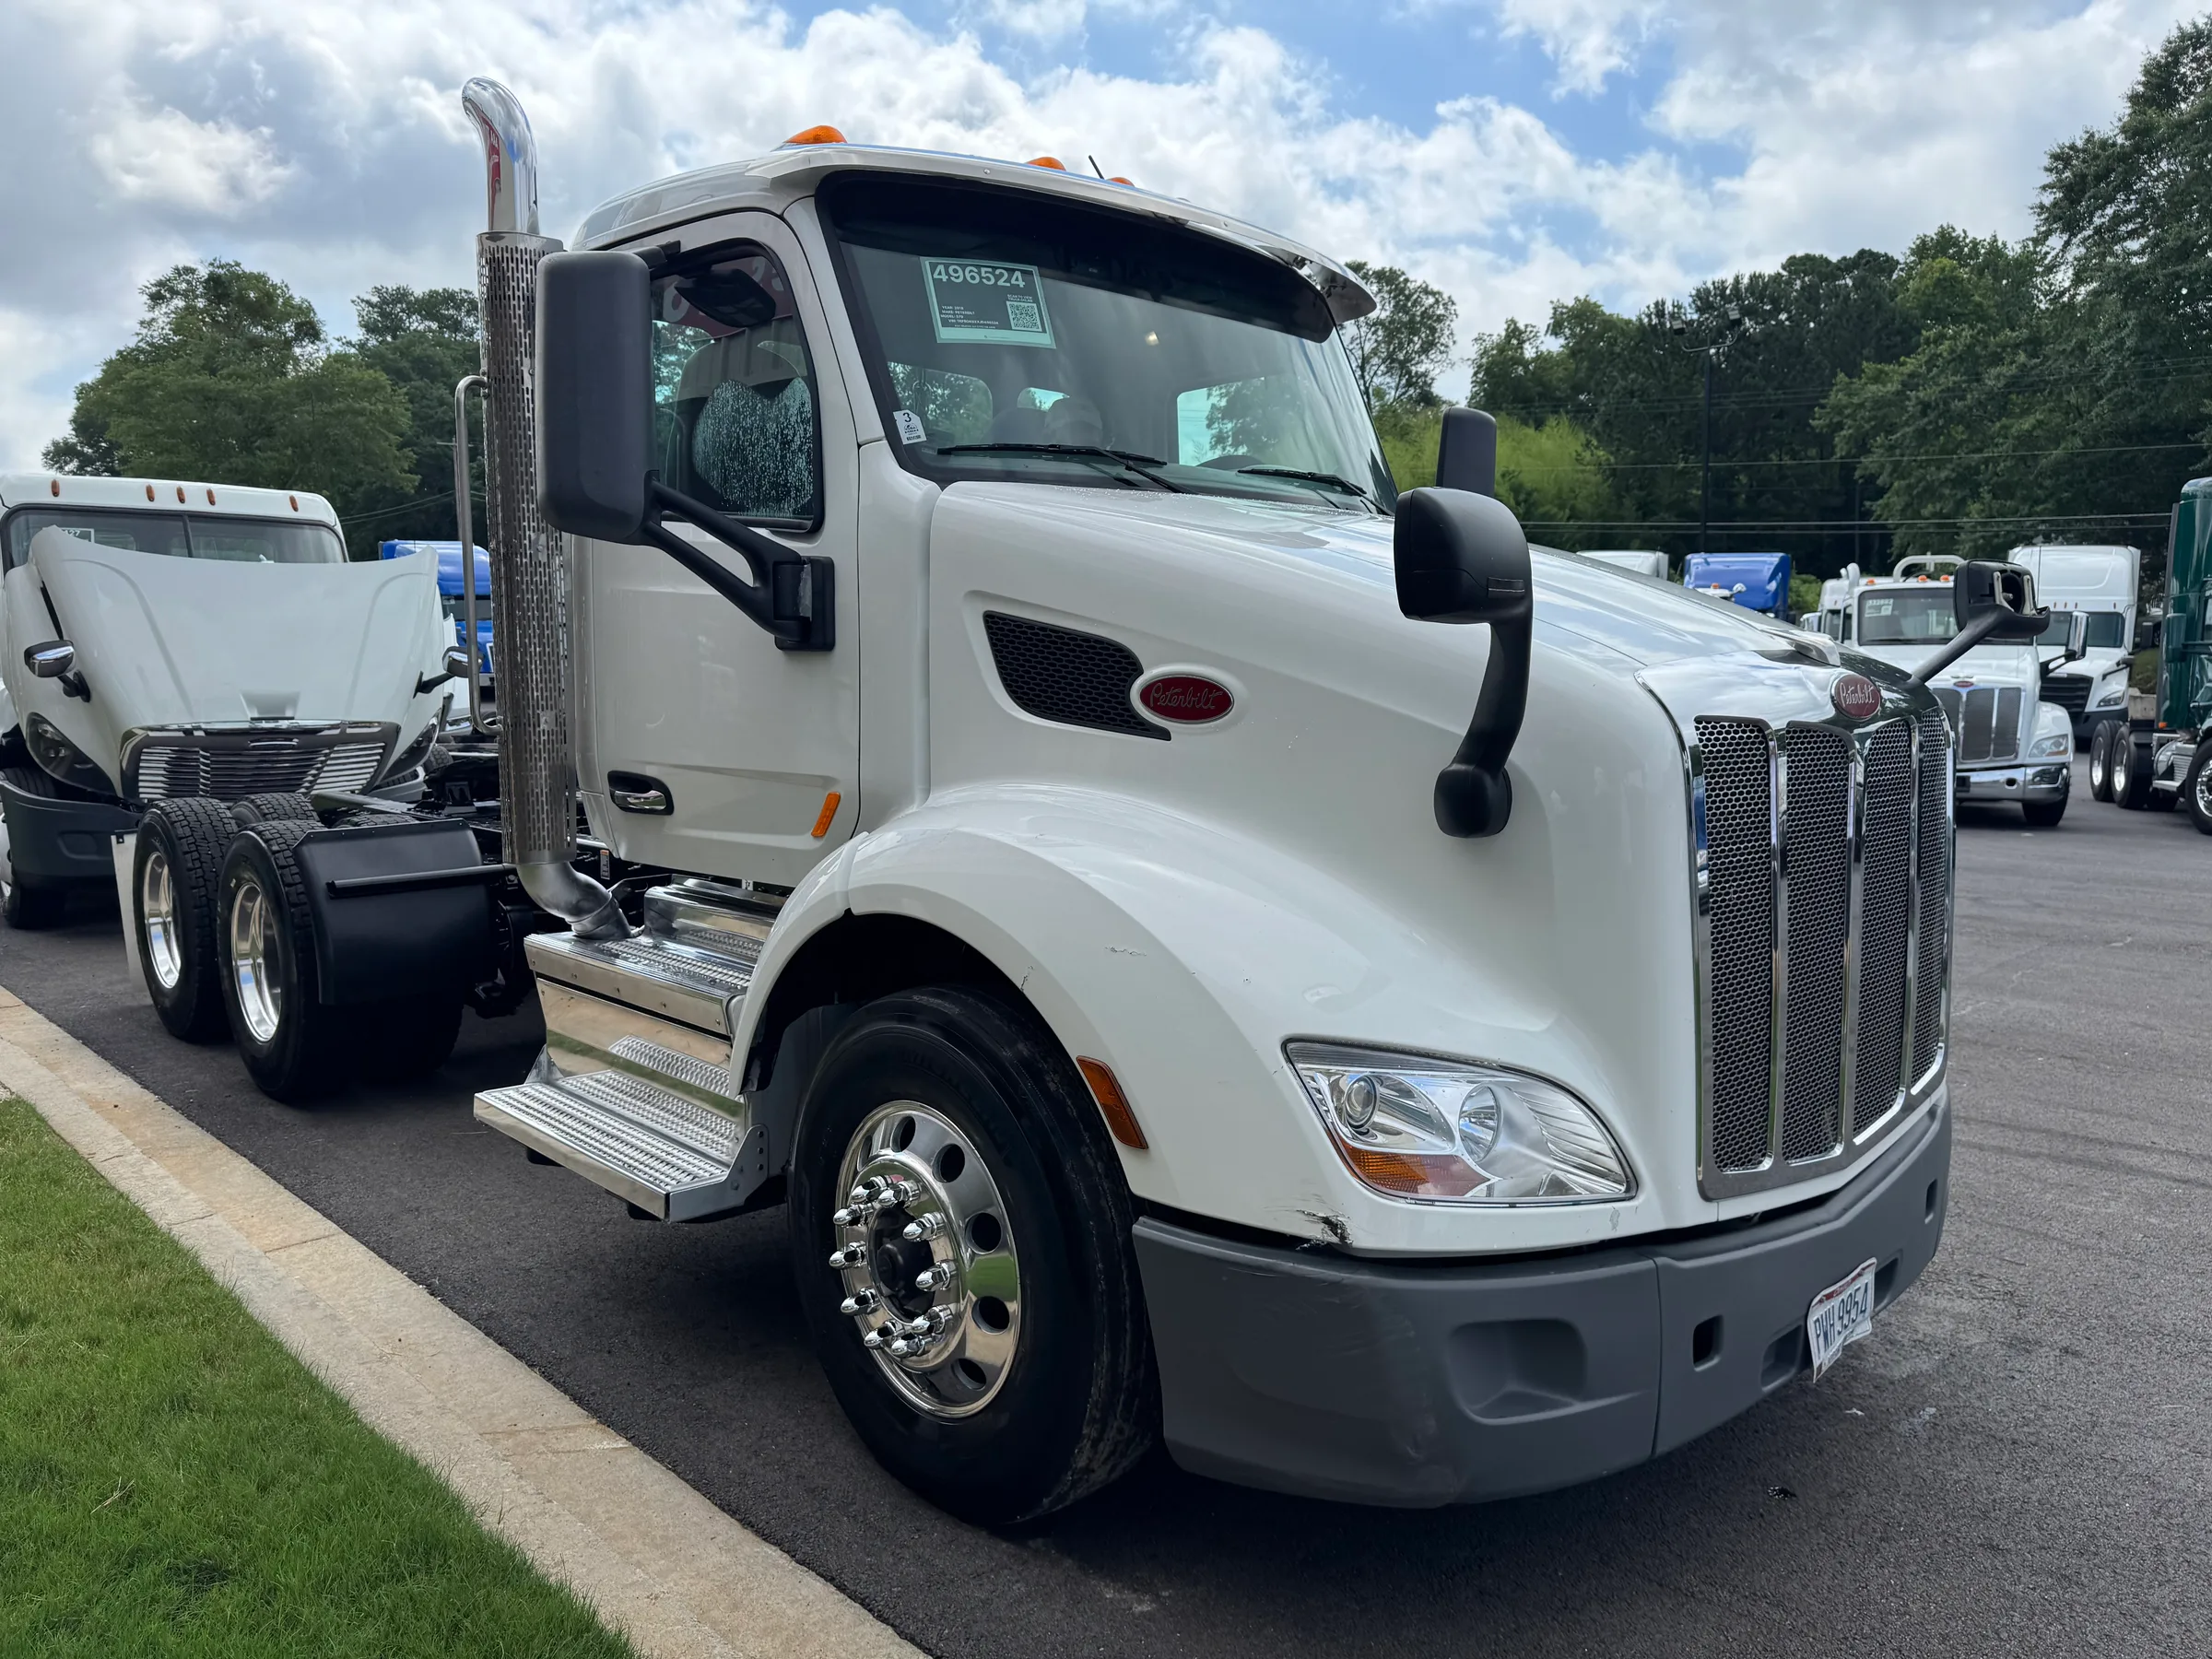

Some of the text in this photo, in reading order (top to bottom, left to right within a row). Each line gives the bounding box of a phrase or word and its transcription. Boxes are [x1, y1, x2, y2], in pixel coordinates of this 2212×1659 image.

[933, 264, 1025, 288] 496524
[902, 412, 912, 423] 3
[1149, 682, 1224, 710] Peterbilt
[1840, 682, 1875, 708] Peterbilt
[1837, 1282, 1869, 1335] 9954
